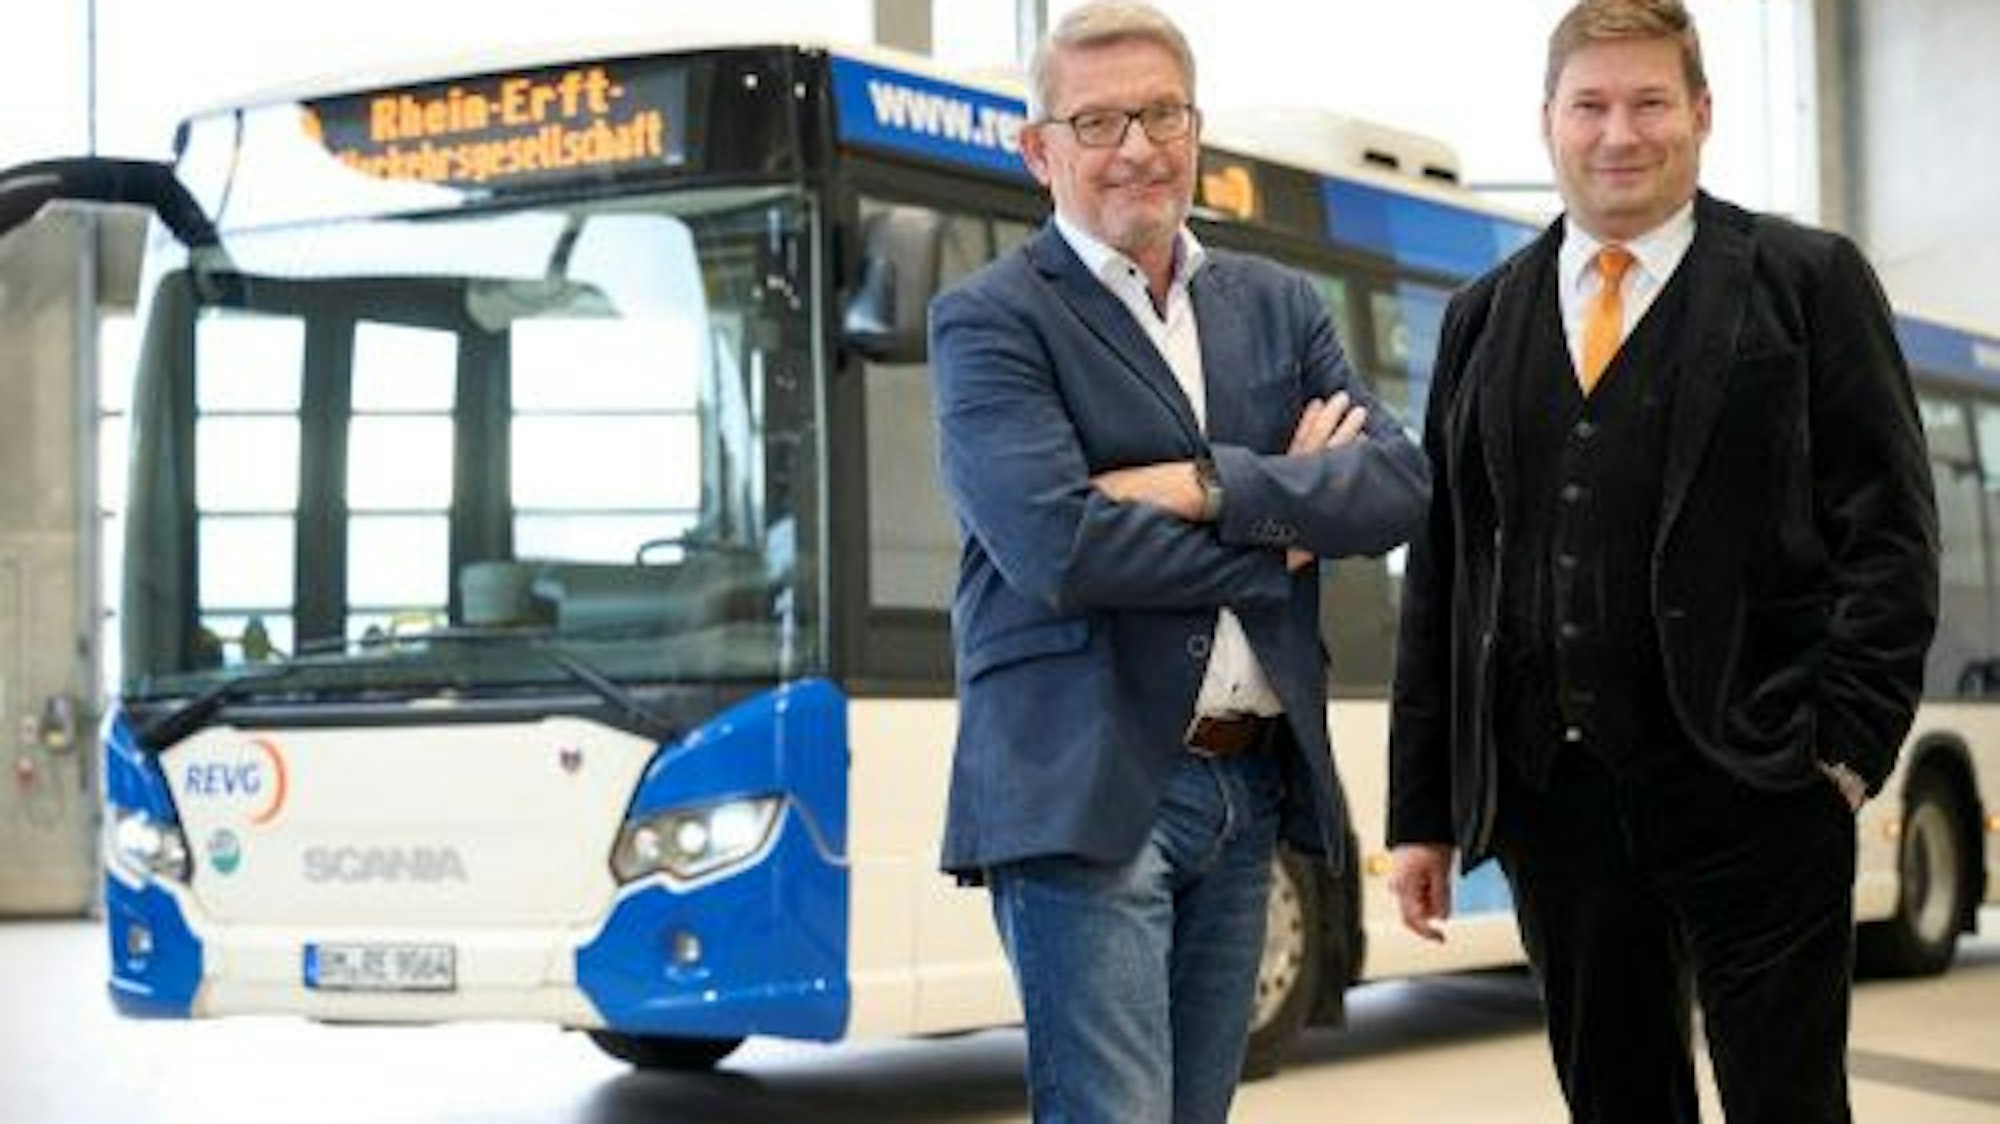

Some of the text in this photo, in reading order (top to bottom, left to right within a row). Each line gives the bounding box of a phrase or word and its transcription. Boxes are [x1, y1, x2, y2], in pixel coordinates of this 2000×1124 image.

[369, 67, 625, 142] Rhein-Erft-
[184, 764, 261, 796] REVG
[302, 846, 468, 884] SCANIA
